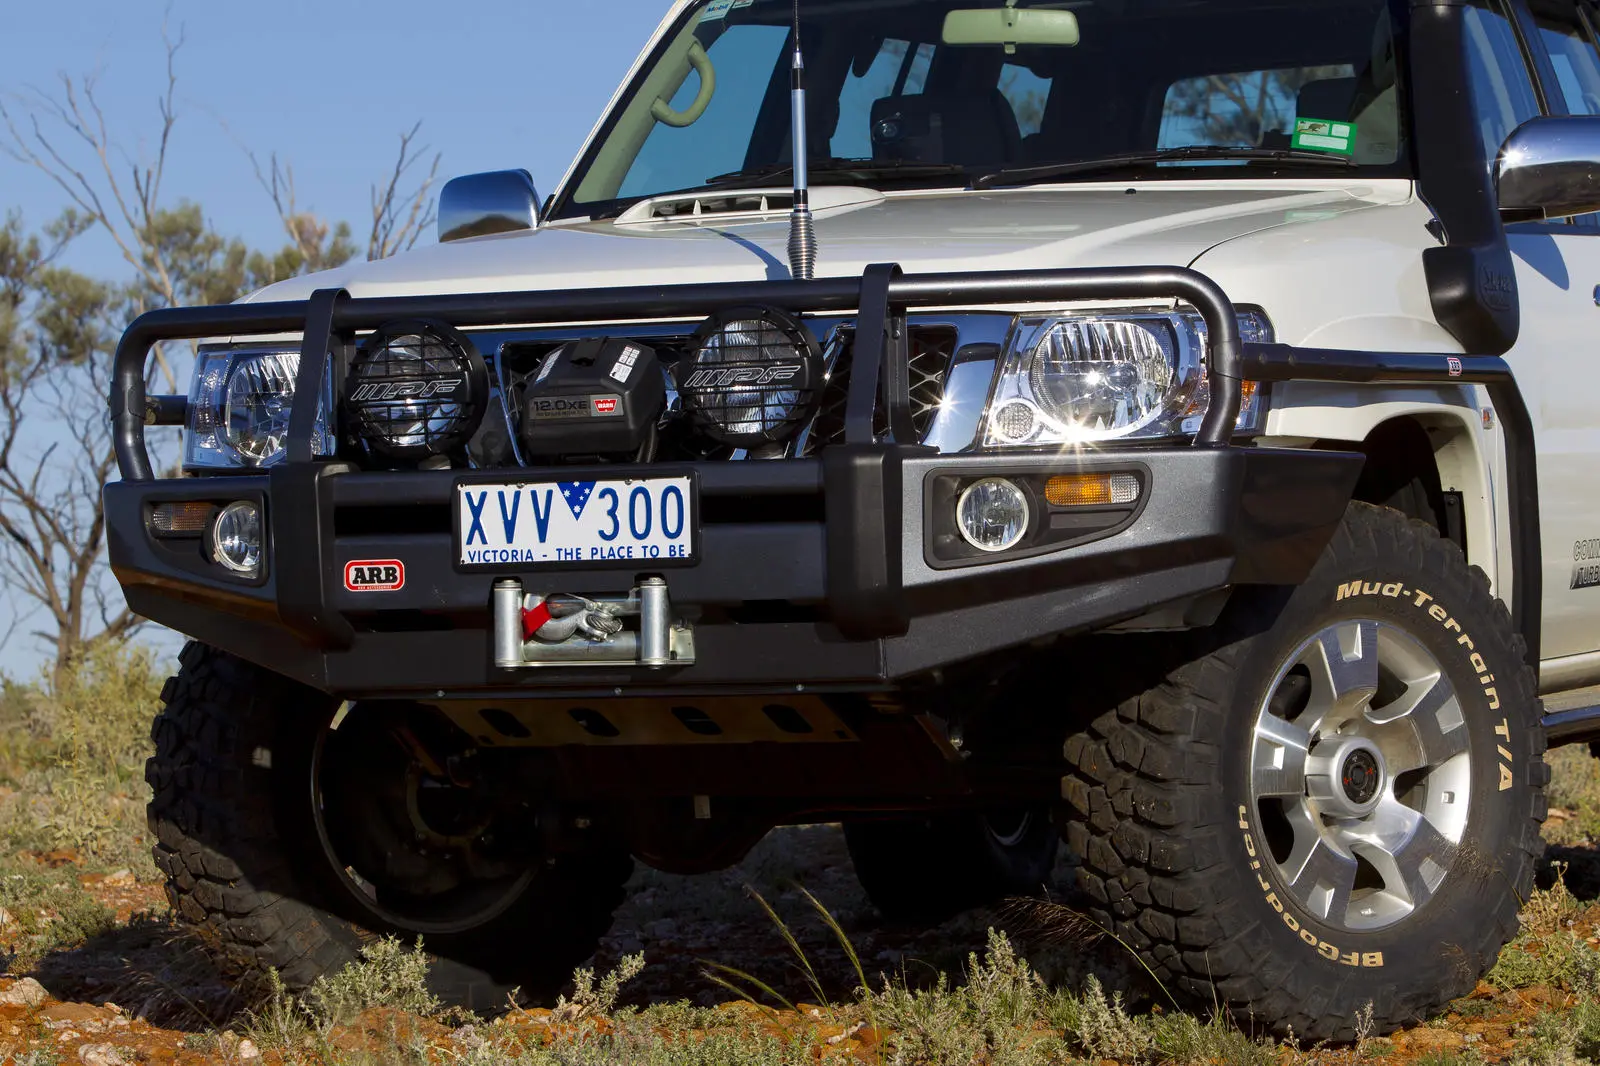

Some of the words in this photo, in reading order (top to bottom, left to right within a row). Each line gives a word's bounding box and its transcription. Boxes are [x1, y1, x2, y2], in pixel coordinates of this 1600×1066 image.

[534, 400, 588, 411] 12.0XE
[465, 489, 553, 545] XVV
[598, 485, 685, 541] 300
[467, 549, 534, 562] VICTORIA
[556, 547, 582, 560] THE
[590, 545, 633, 560] PLACE
[641, 545, 660, 558] TO
[669, 544, 685, 557] BE
[352, 566, 398, 584] ARB
[1336, 580, 1500, 710] Mud-Terrain
[1494, 717, 1513, 791] T/A
[1238, 805, 1384, 967] BFGoodrich
